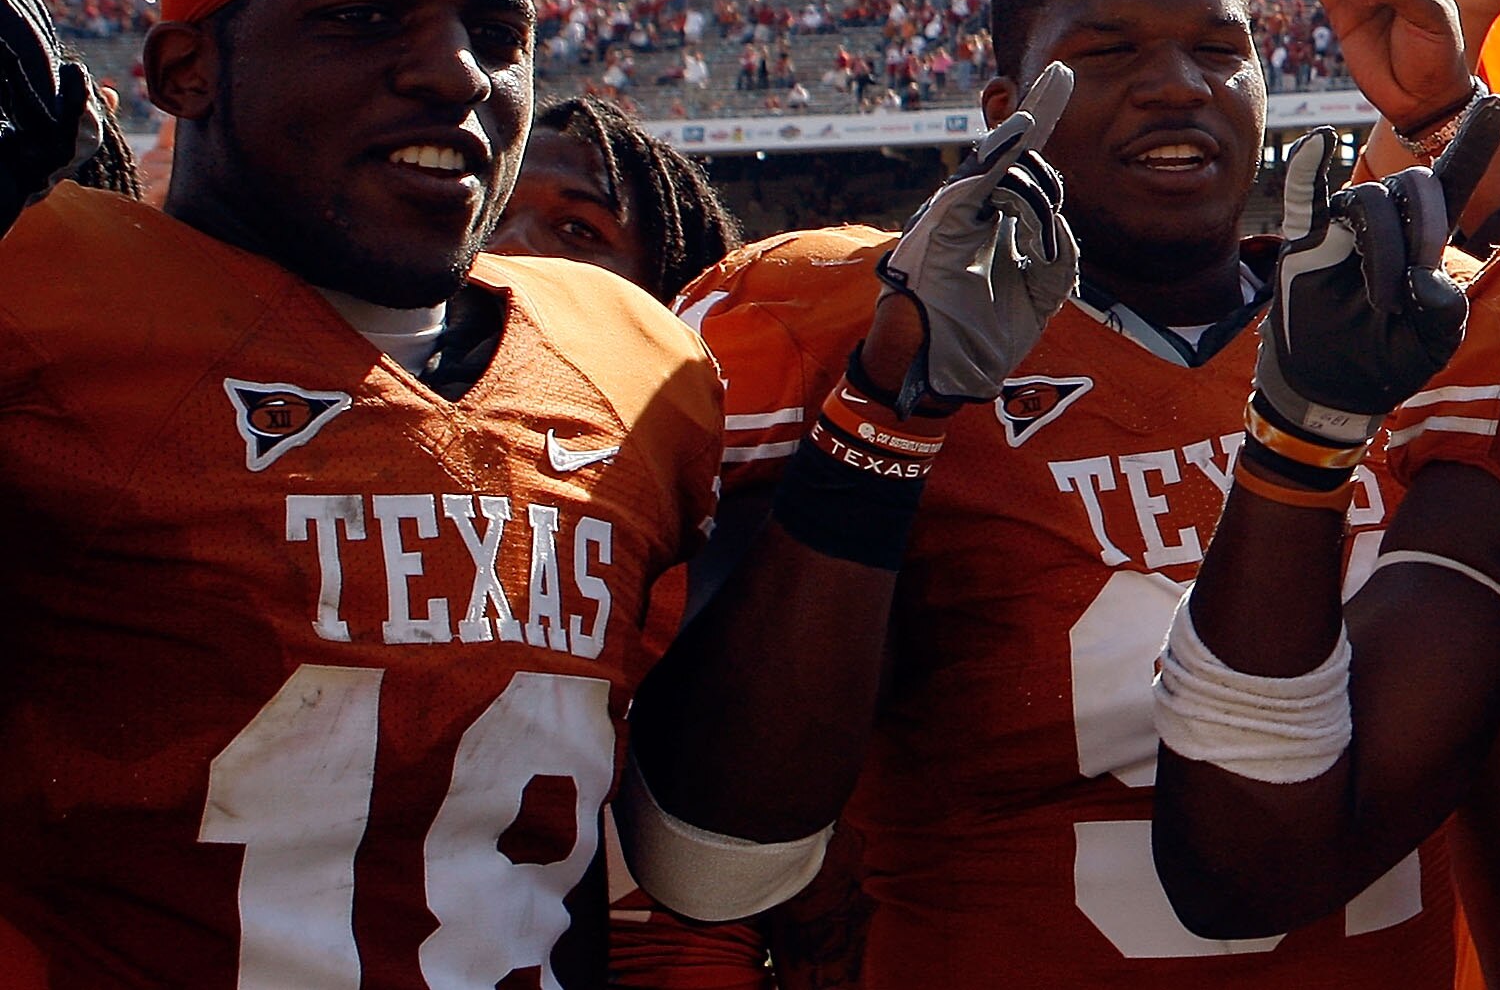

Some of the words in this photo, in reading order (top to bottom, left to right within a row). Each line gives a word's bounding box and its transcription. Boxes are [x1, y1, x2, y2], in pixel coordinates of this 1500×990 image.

[831, 437, 921, 478] TEXAS
[286, 494, 613, 660] TEXAS
[197, 663, 617, 989] 18
